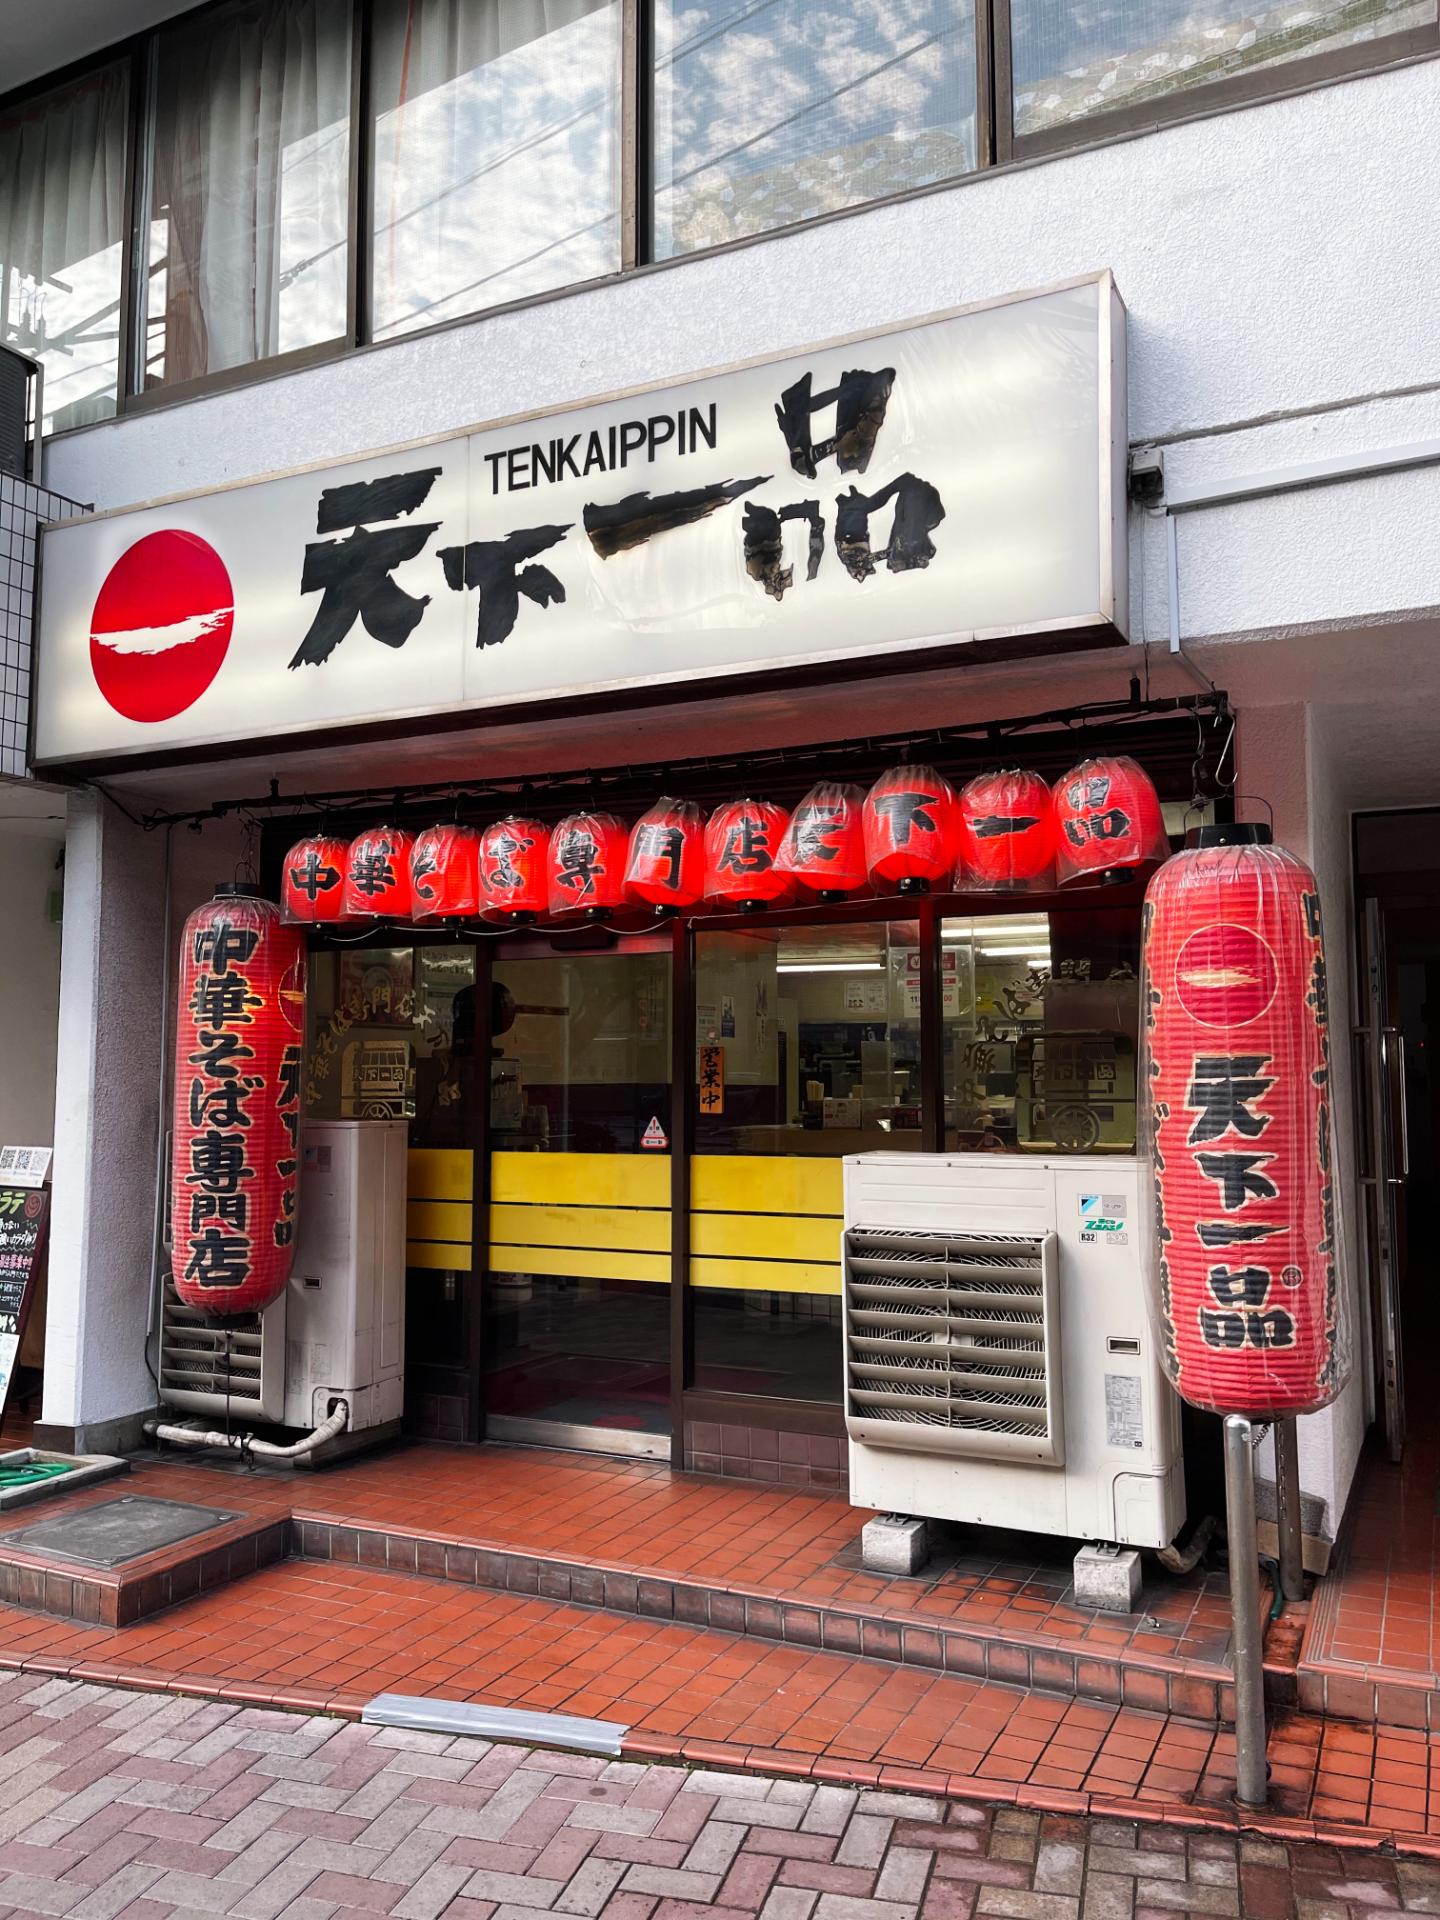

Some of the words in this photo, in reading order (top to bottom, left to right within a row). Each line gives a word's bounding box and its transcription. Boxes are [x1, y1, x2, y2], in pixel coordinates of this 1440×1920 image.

[288, 366, 946, 671] 天下一品
[484, 403, 717, 494] TENKAIPPIN
[185, 924, 264, 1290] 中華そば専門店
[702, 1048, 721, 1111] 営業中
[1081, 1233, 1095, 1242] R32
[1188, 1054, 1296, 1349] 天下一品
